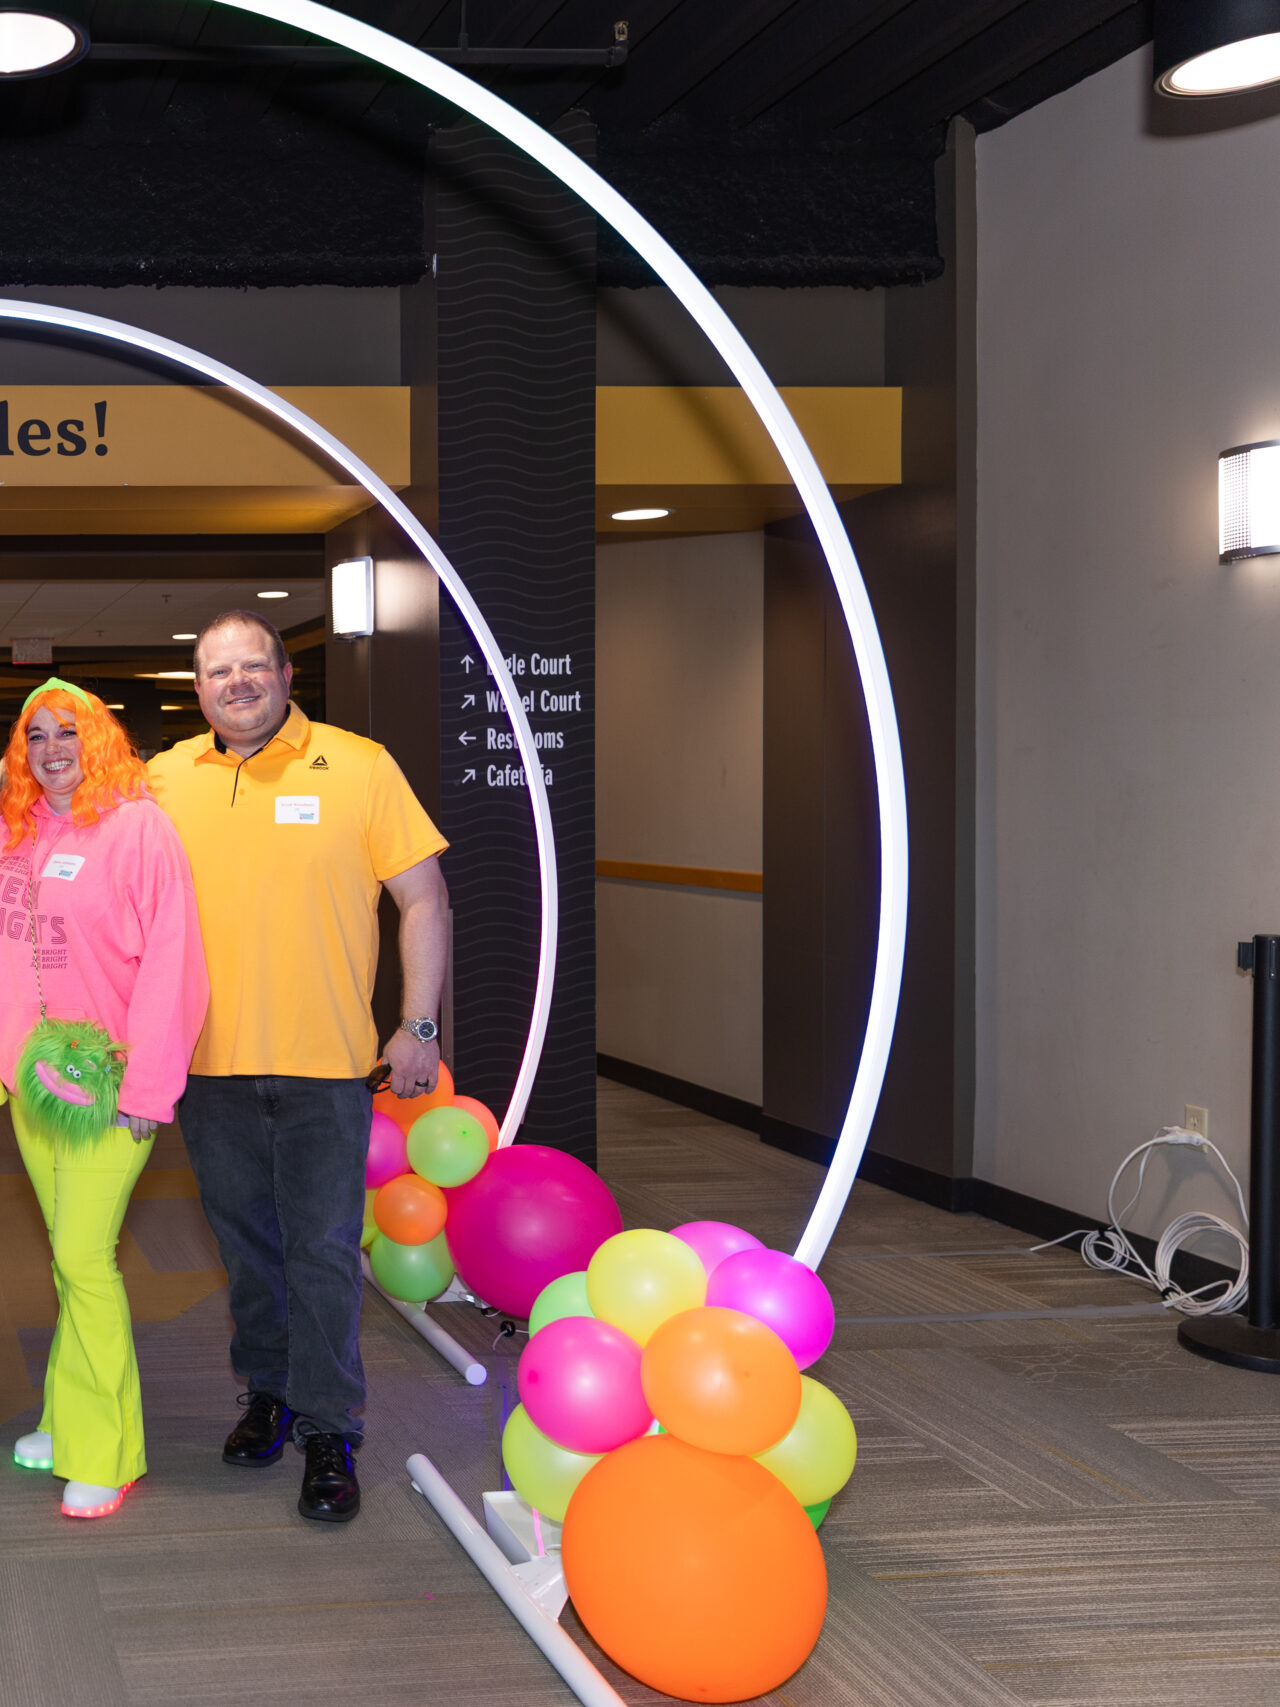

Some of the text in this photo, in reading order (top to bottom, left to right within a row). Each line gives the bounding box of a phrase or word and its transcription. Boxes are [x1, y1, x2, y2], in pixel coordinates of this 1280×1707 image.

[486, 652, 572, 676] gle Court
[486, 690, 582, 713] Weel Court
[487, 728, 564, 750] Restoms
[487, 764, 553, 787] Cafetia
